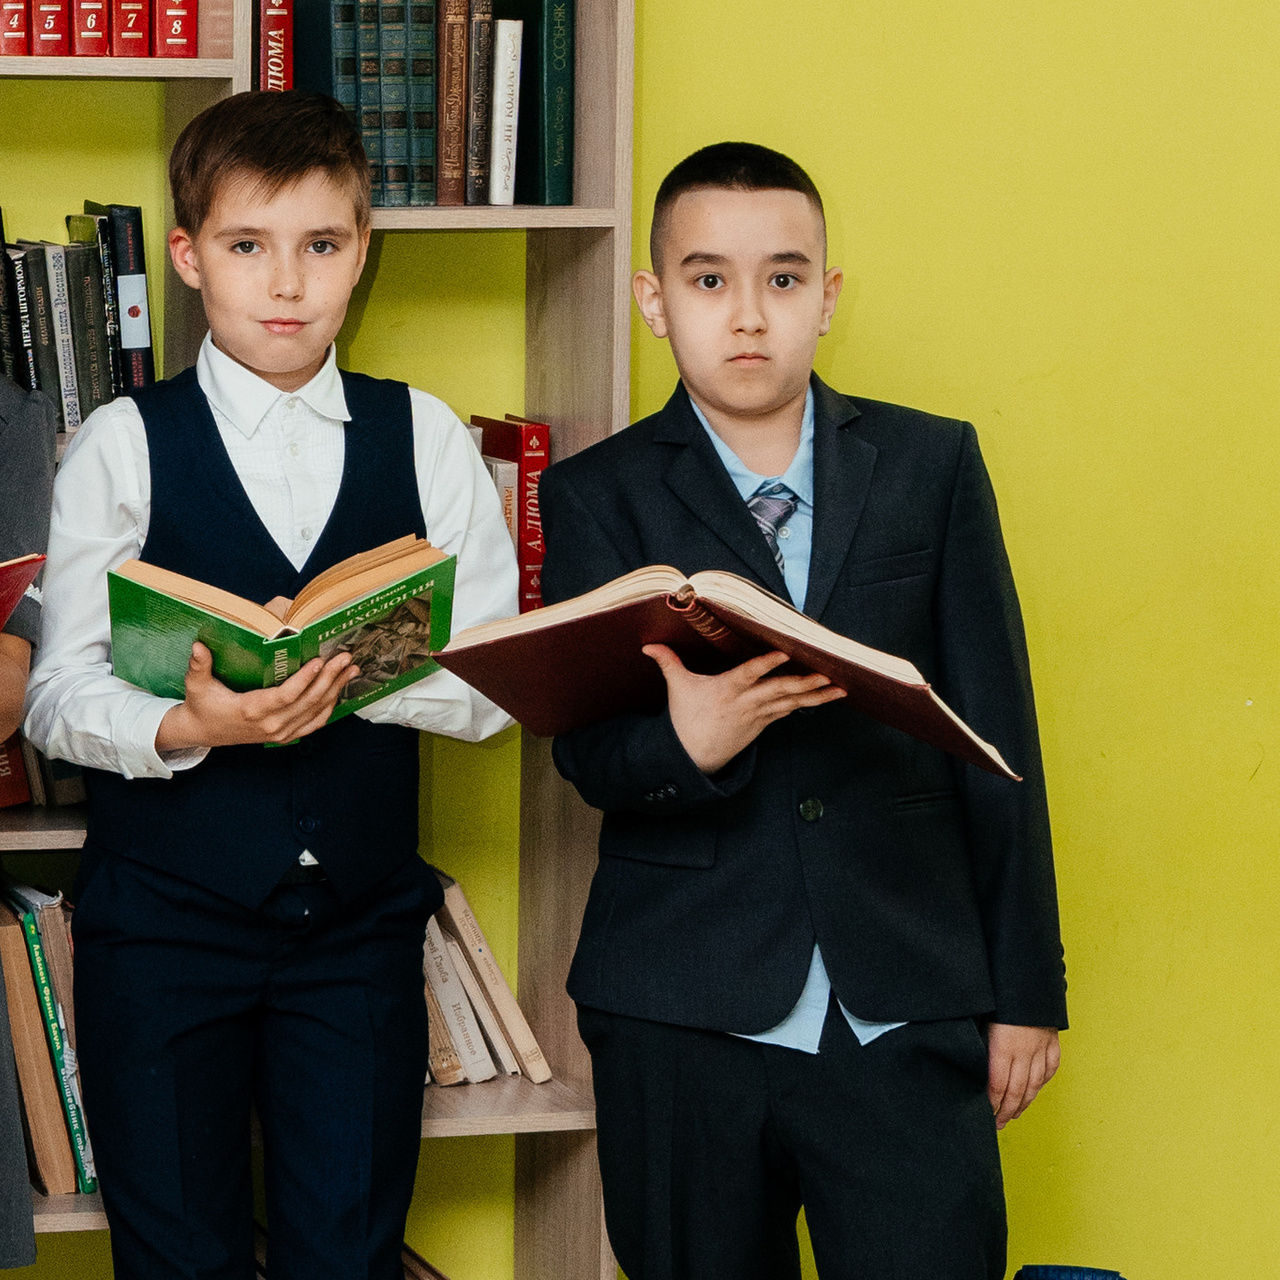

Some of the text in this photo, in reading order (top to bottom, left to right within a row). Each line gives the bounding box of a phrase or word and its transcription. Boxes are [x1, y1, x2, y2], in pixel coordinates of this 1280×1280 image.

[9, 14, 19, 28] 4
[44, 16, 54, 30] 5
[87, 14, 96, 29] 6
[128, 13, 136, 29] 7
[172, 20, 181, 35] 8
[553, 3, 566, 70] ОСОБНЯК
[504, 66, 514, 143] ЯН КОЛЛАР
[15, 261, 31, 347] ПЕРЕД ШТОРМОМ
[318, 579, 435, 641] ПСИХОЛОГИЯ
[33, 944, 61, 1050] Лаймен Фрэнк Баум
[452, 1002, 477, 1056] Избранное
